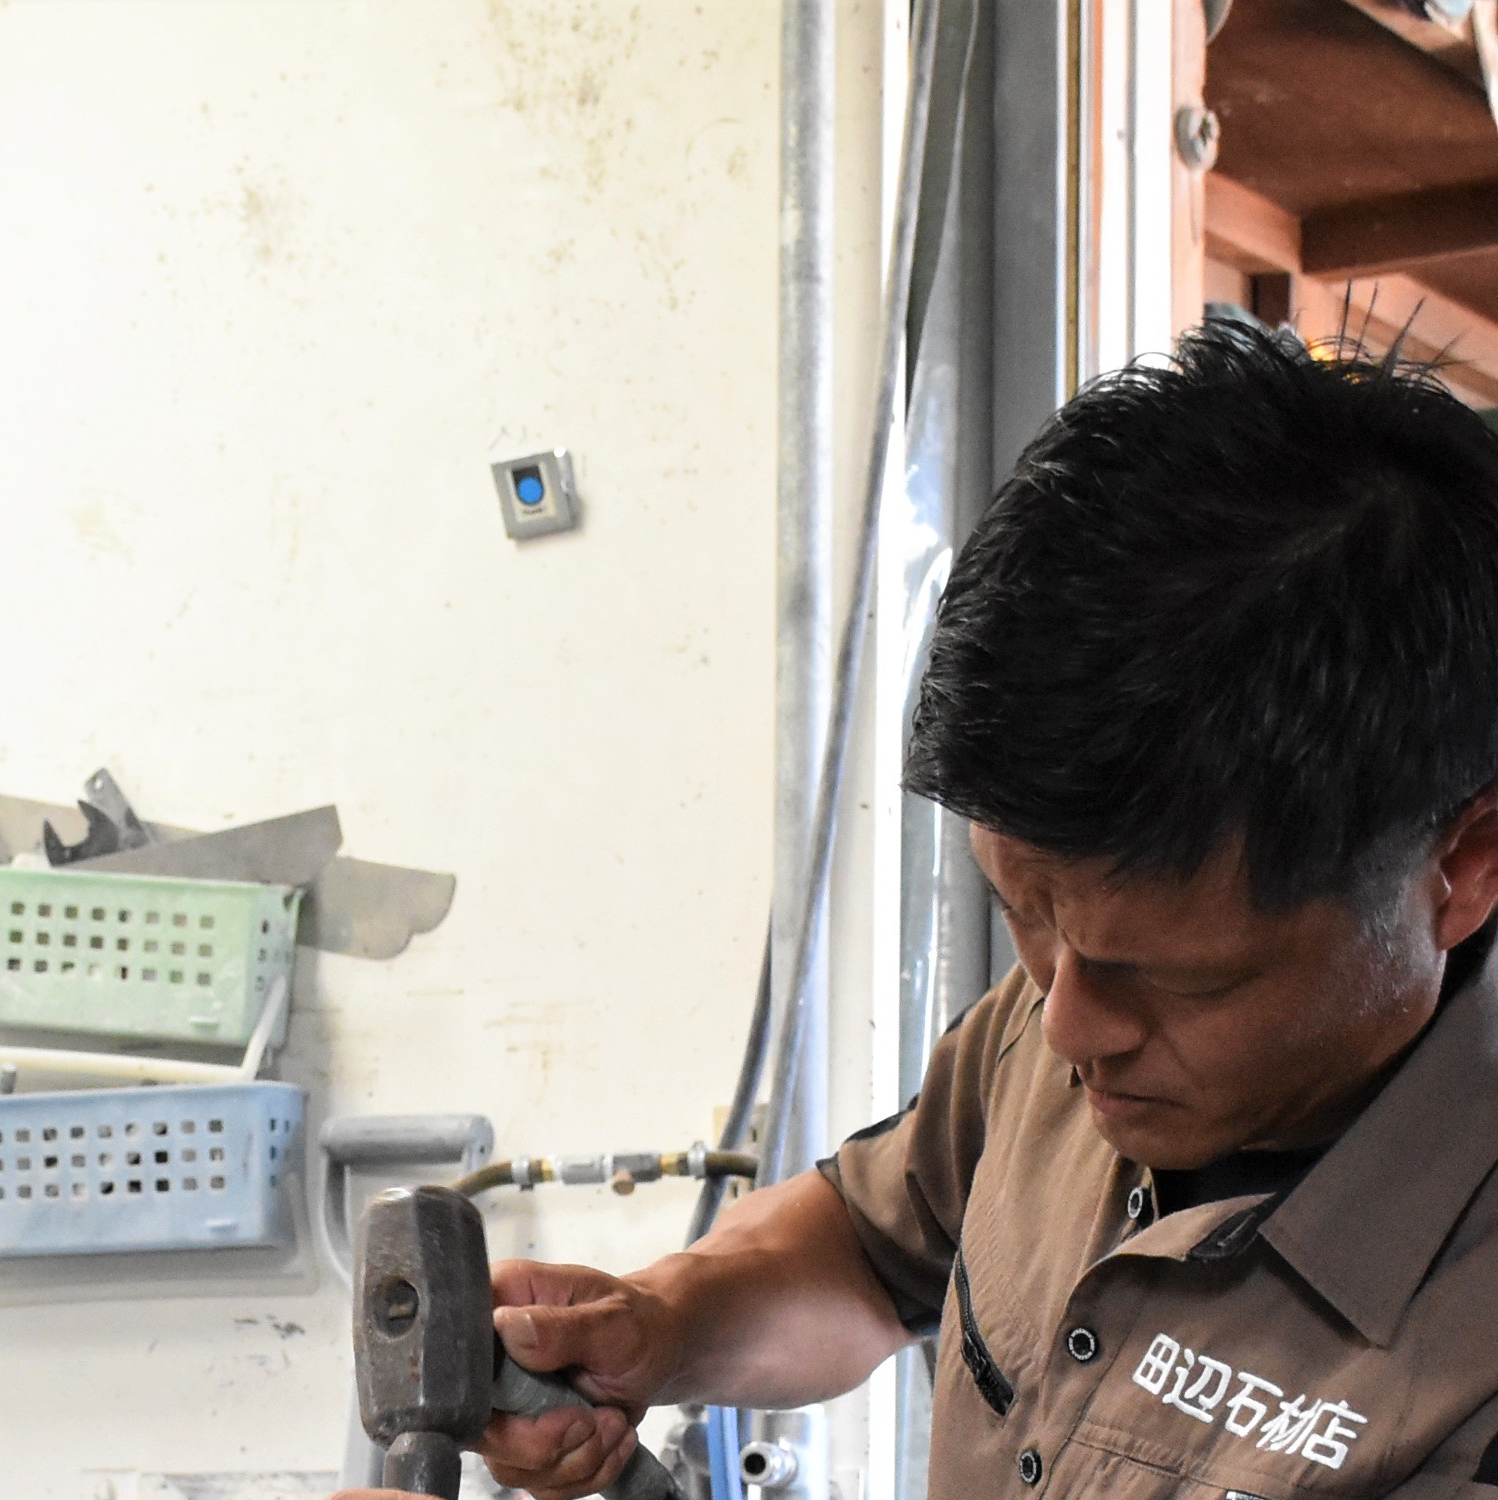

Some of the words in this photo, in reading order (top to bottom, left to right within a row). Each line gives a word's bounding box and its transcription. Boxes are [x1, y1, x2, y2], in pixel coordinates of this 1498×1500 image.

[1132, 1333, 1368, 1470] 田辺石材店
